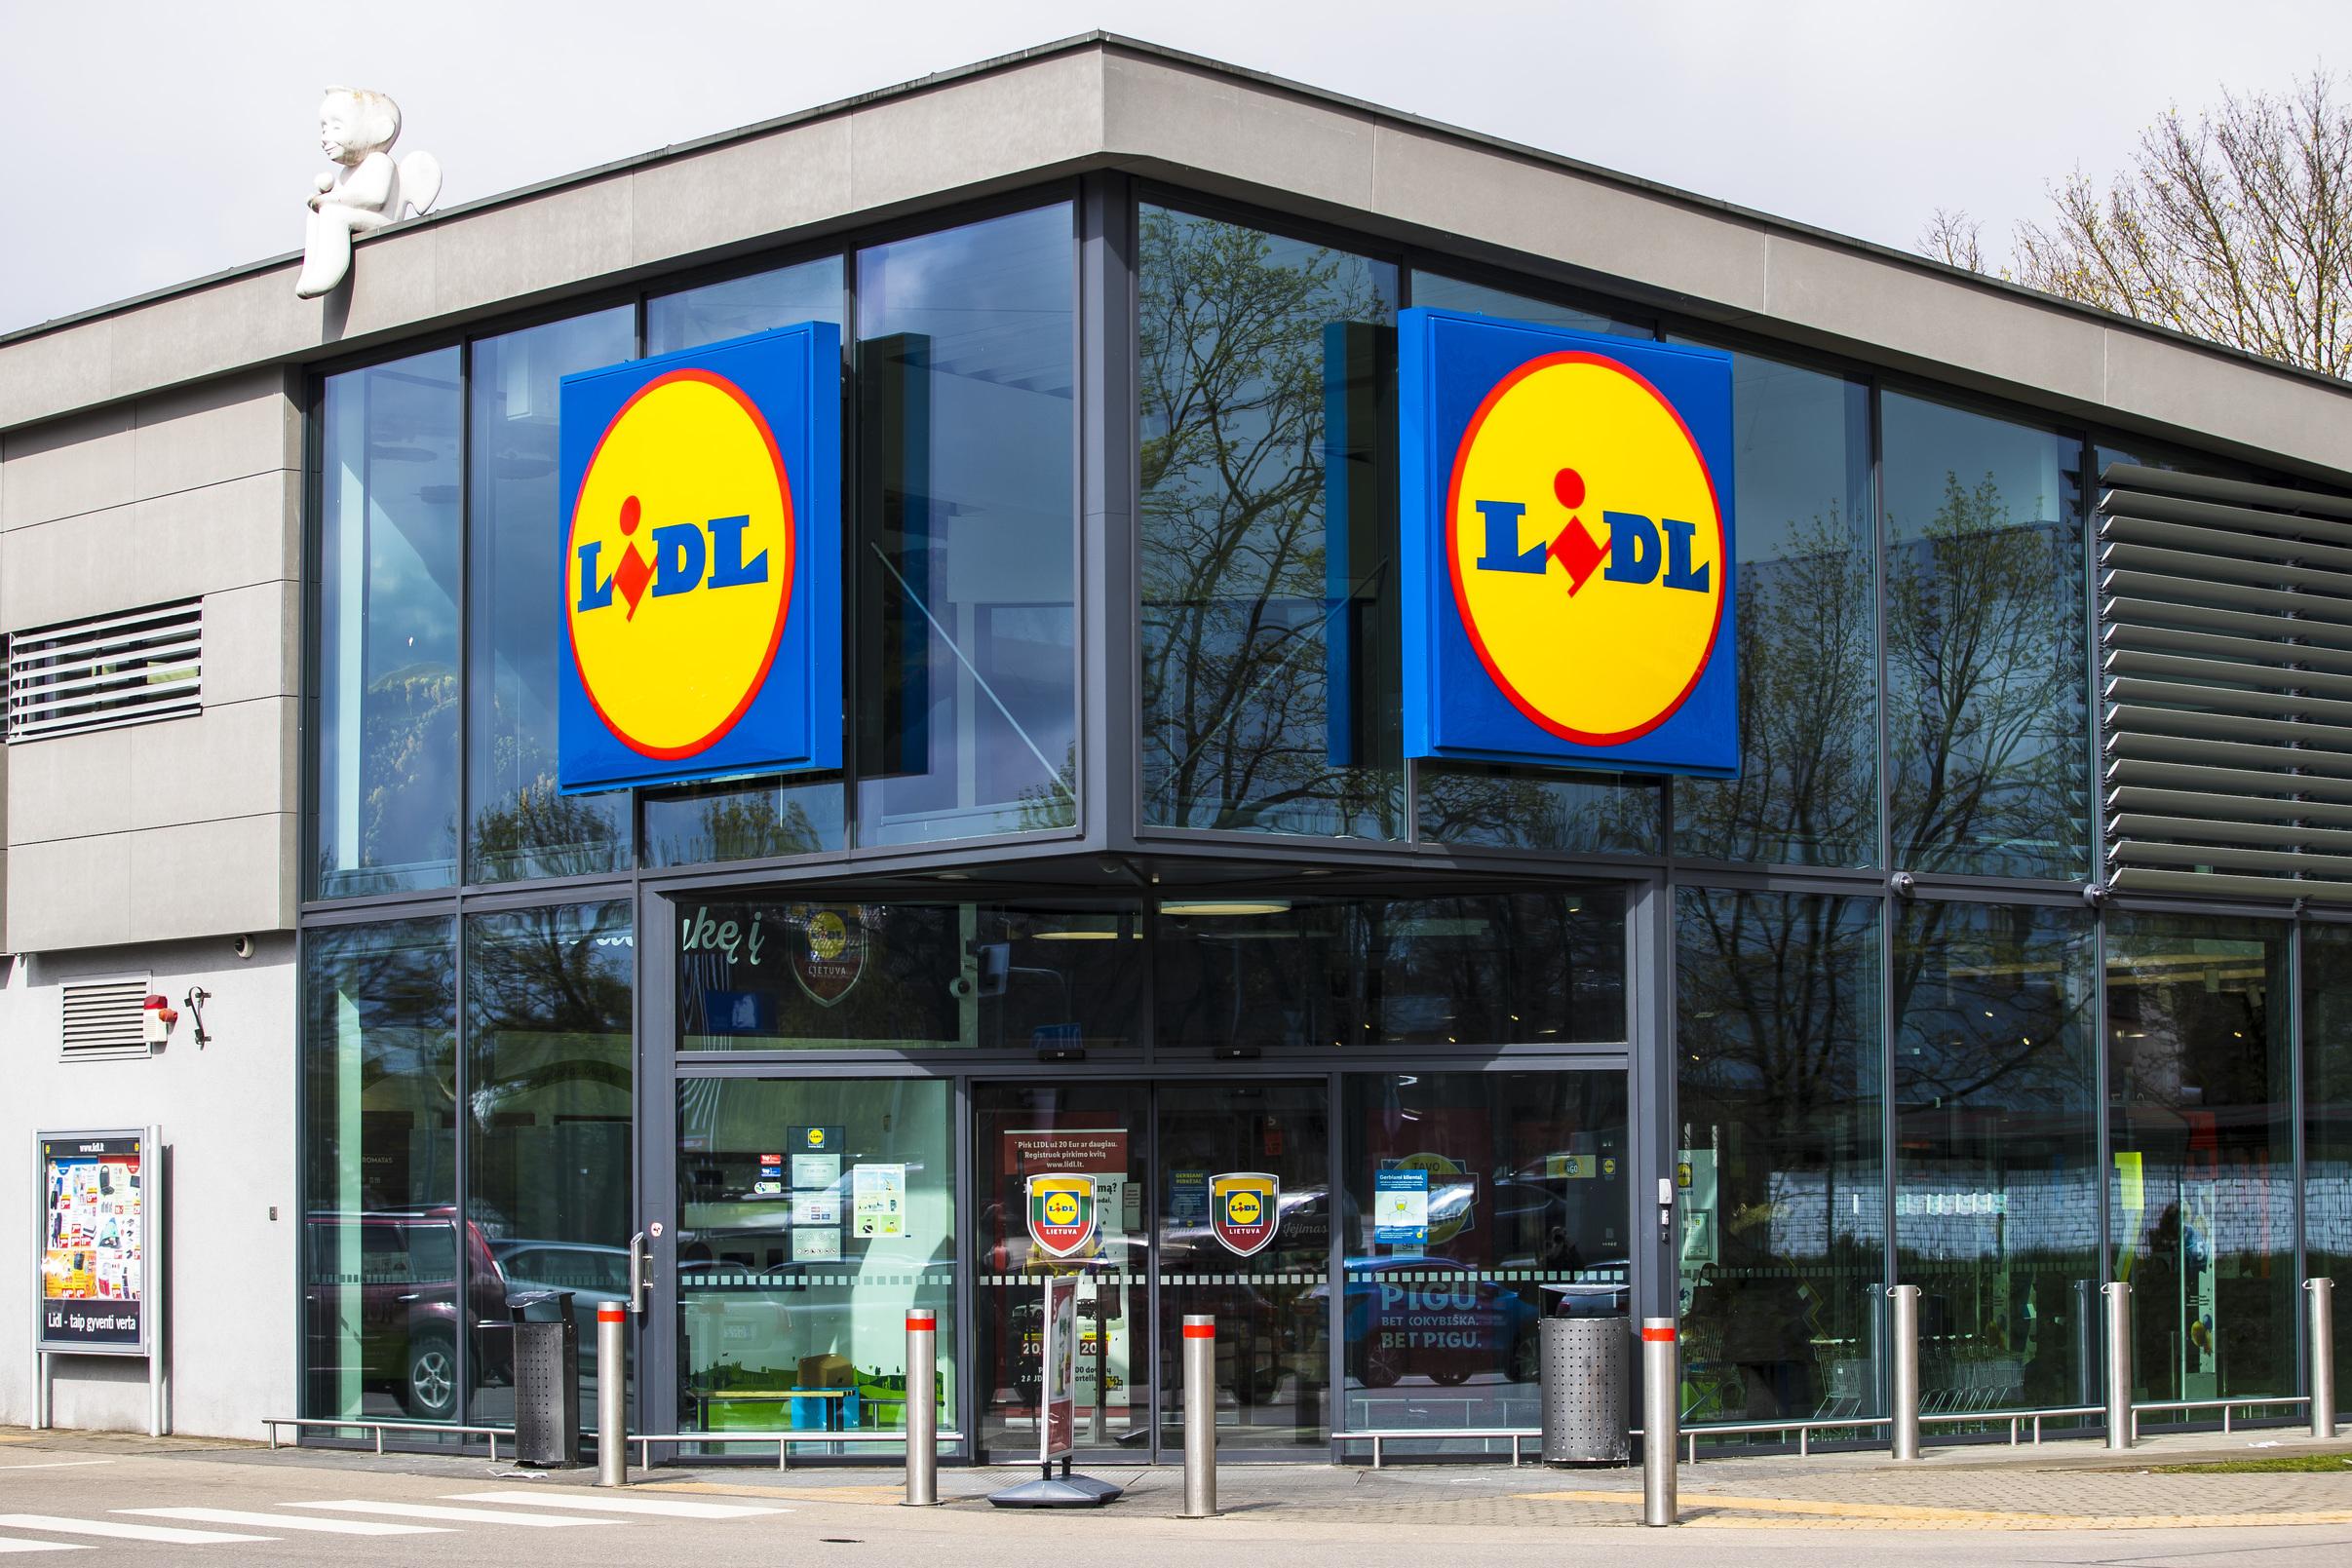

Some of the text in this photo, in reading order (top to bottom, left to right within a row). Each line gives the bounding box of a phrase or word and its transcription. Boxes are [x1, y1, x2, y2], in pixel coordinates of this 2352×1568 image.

[808, 966, 847, 975] LIETUVA
[1089, 1140, 1118, 1149] daugiau.
[1024, 1151, 1106, 1160] Registruok pirkimo kvitą
[1411, 1162, 1441, 1172] TAVO
[1049, 1202, 1075, 1213] LIDL
[1230, 1202, 1258, 1212] LIDL
[1379, 1282, 1482, 1311] PIGU.
[48, 1312, 62, 1328] Lidl
[70, 1313, 86, 1332] taip
[86, 1315, 115, 1333] gyventi
[116, 1315, 136, 1330] verta
[1381, 1317, 1404, 1326] BET
[1381, 1331, 1482, 1349] BET PIGU.
